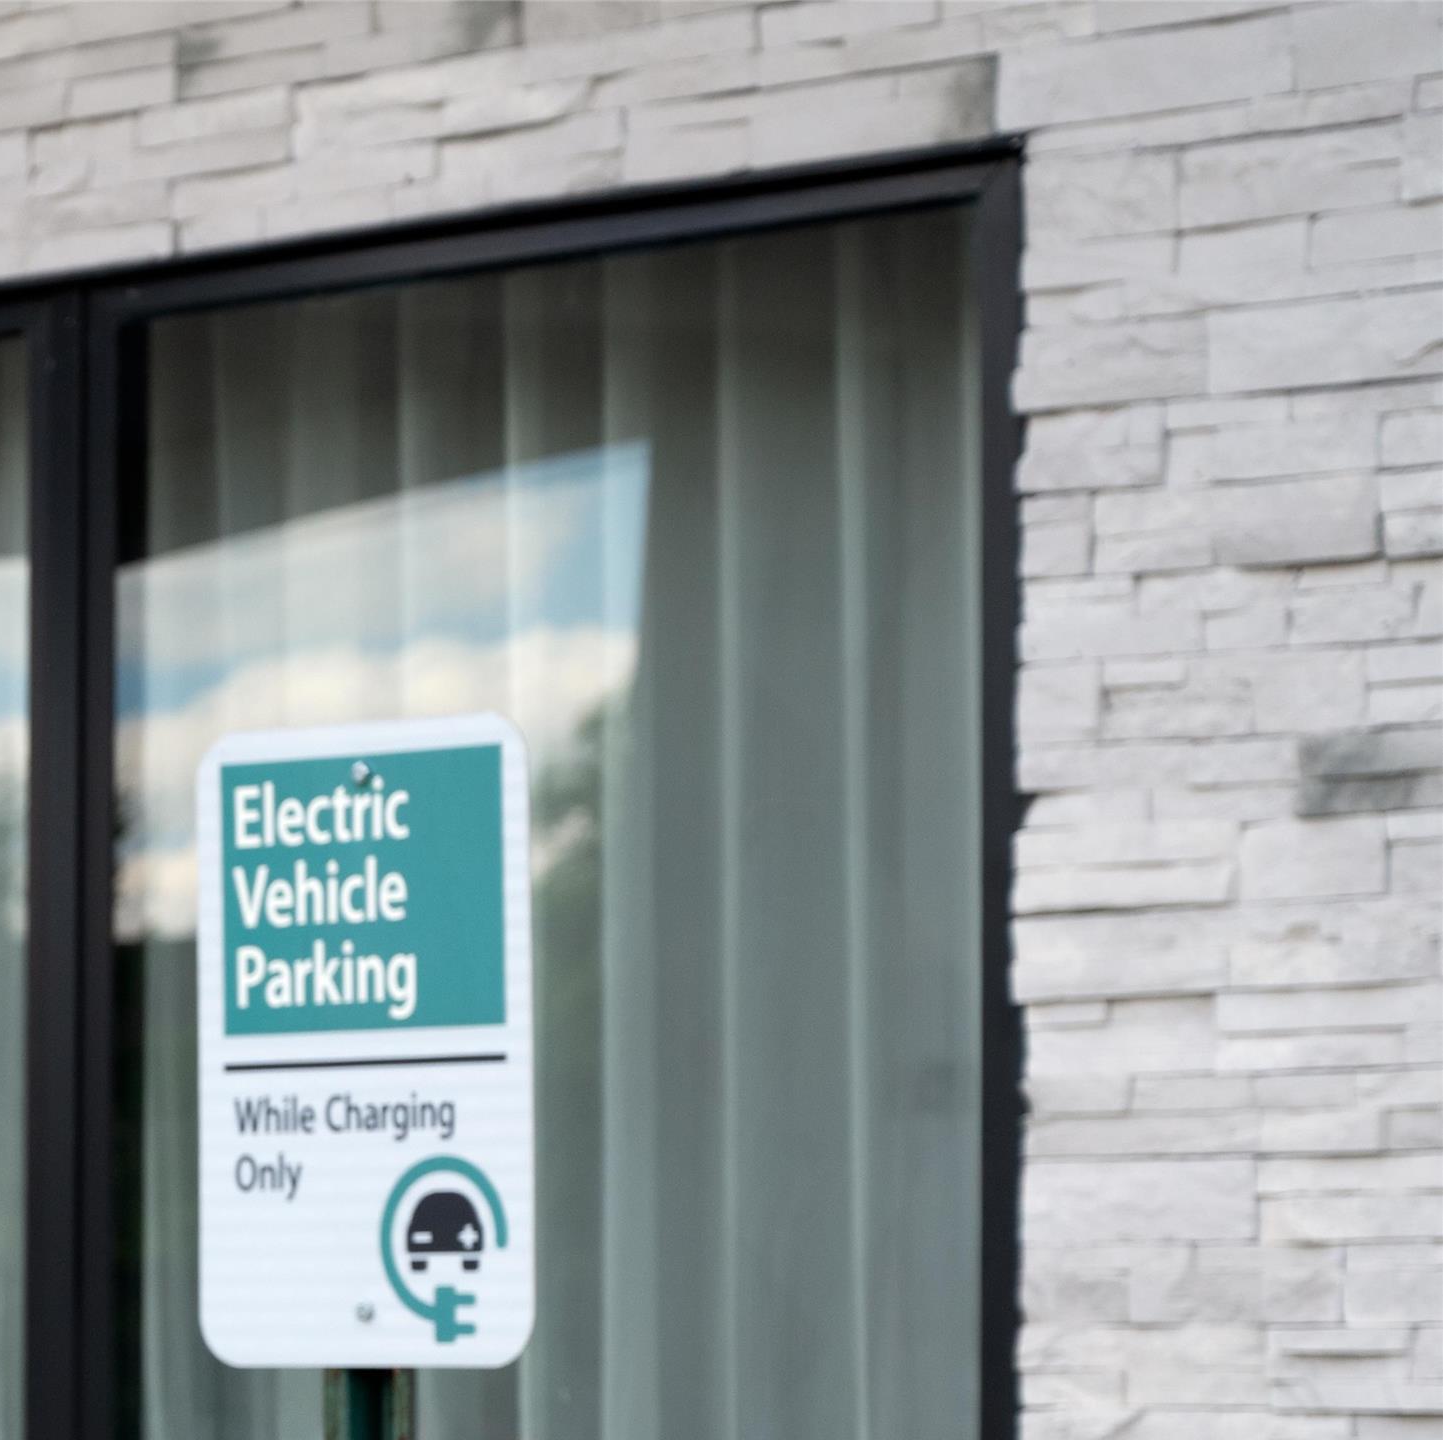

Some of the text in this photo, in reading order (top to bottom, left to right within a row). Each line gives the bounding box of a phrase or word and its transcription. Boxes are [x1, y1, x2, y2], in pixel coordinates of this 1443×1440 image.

[232, 778, 409, 849] Electric
[233, 856, 407, 928] Vehicle
[235, 940, 418, 1020] Parking
[234, 1092, 456, 1141] While Charging
[234, 1154, 303, 1200] Only
